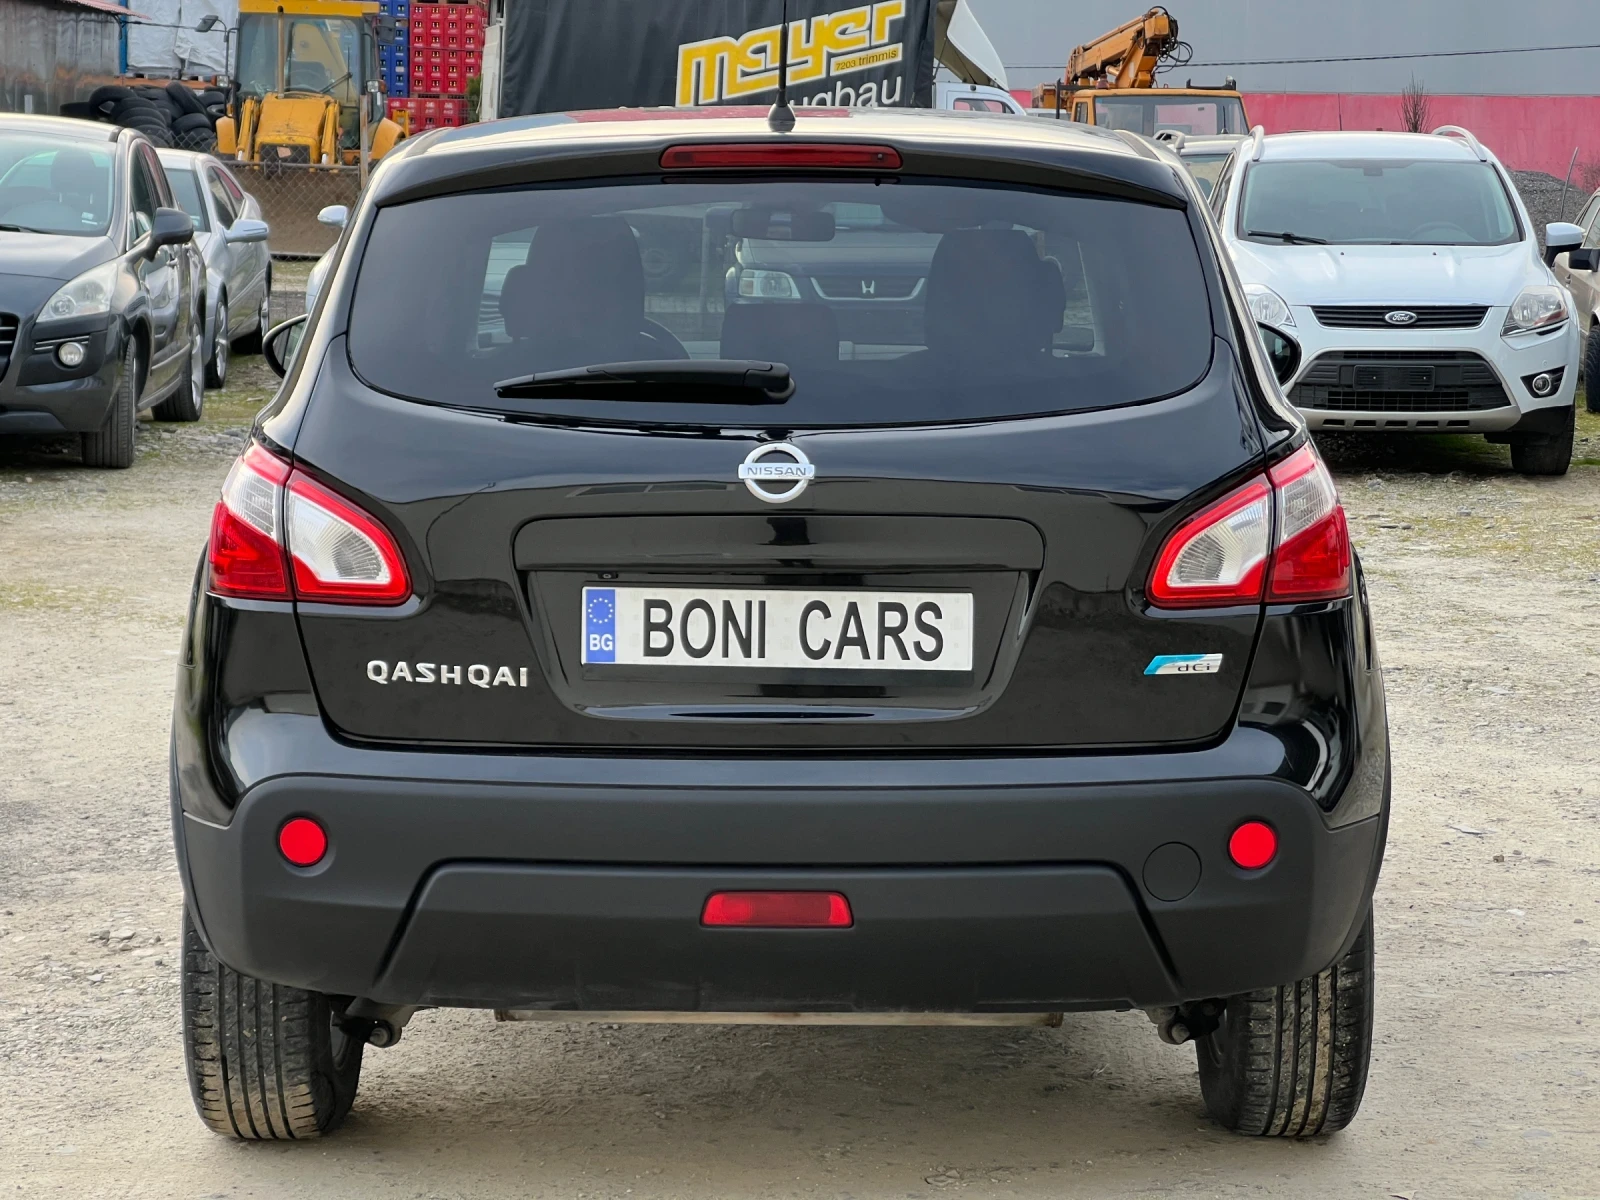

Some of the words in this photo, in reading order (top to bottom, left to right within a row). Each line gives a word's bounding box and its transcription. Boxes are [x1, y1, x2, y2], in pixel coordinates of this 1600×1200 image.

[676, 0, 906, 107] mayer
[835, 60, 856, 71] 7203
[858, 50, 897, 66] trimmis
[747, 466, 807, 476] NISSAN
[643, 598, 766, 659] BONI
[798, 599, 944, 662] CARS
[589, 634, 613, 651] BG
[366, 660, 528, 689] QASHQAI
[1177, 663, 1210, 672] dCi
